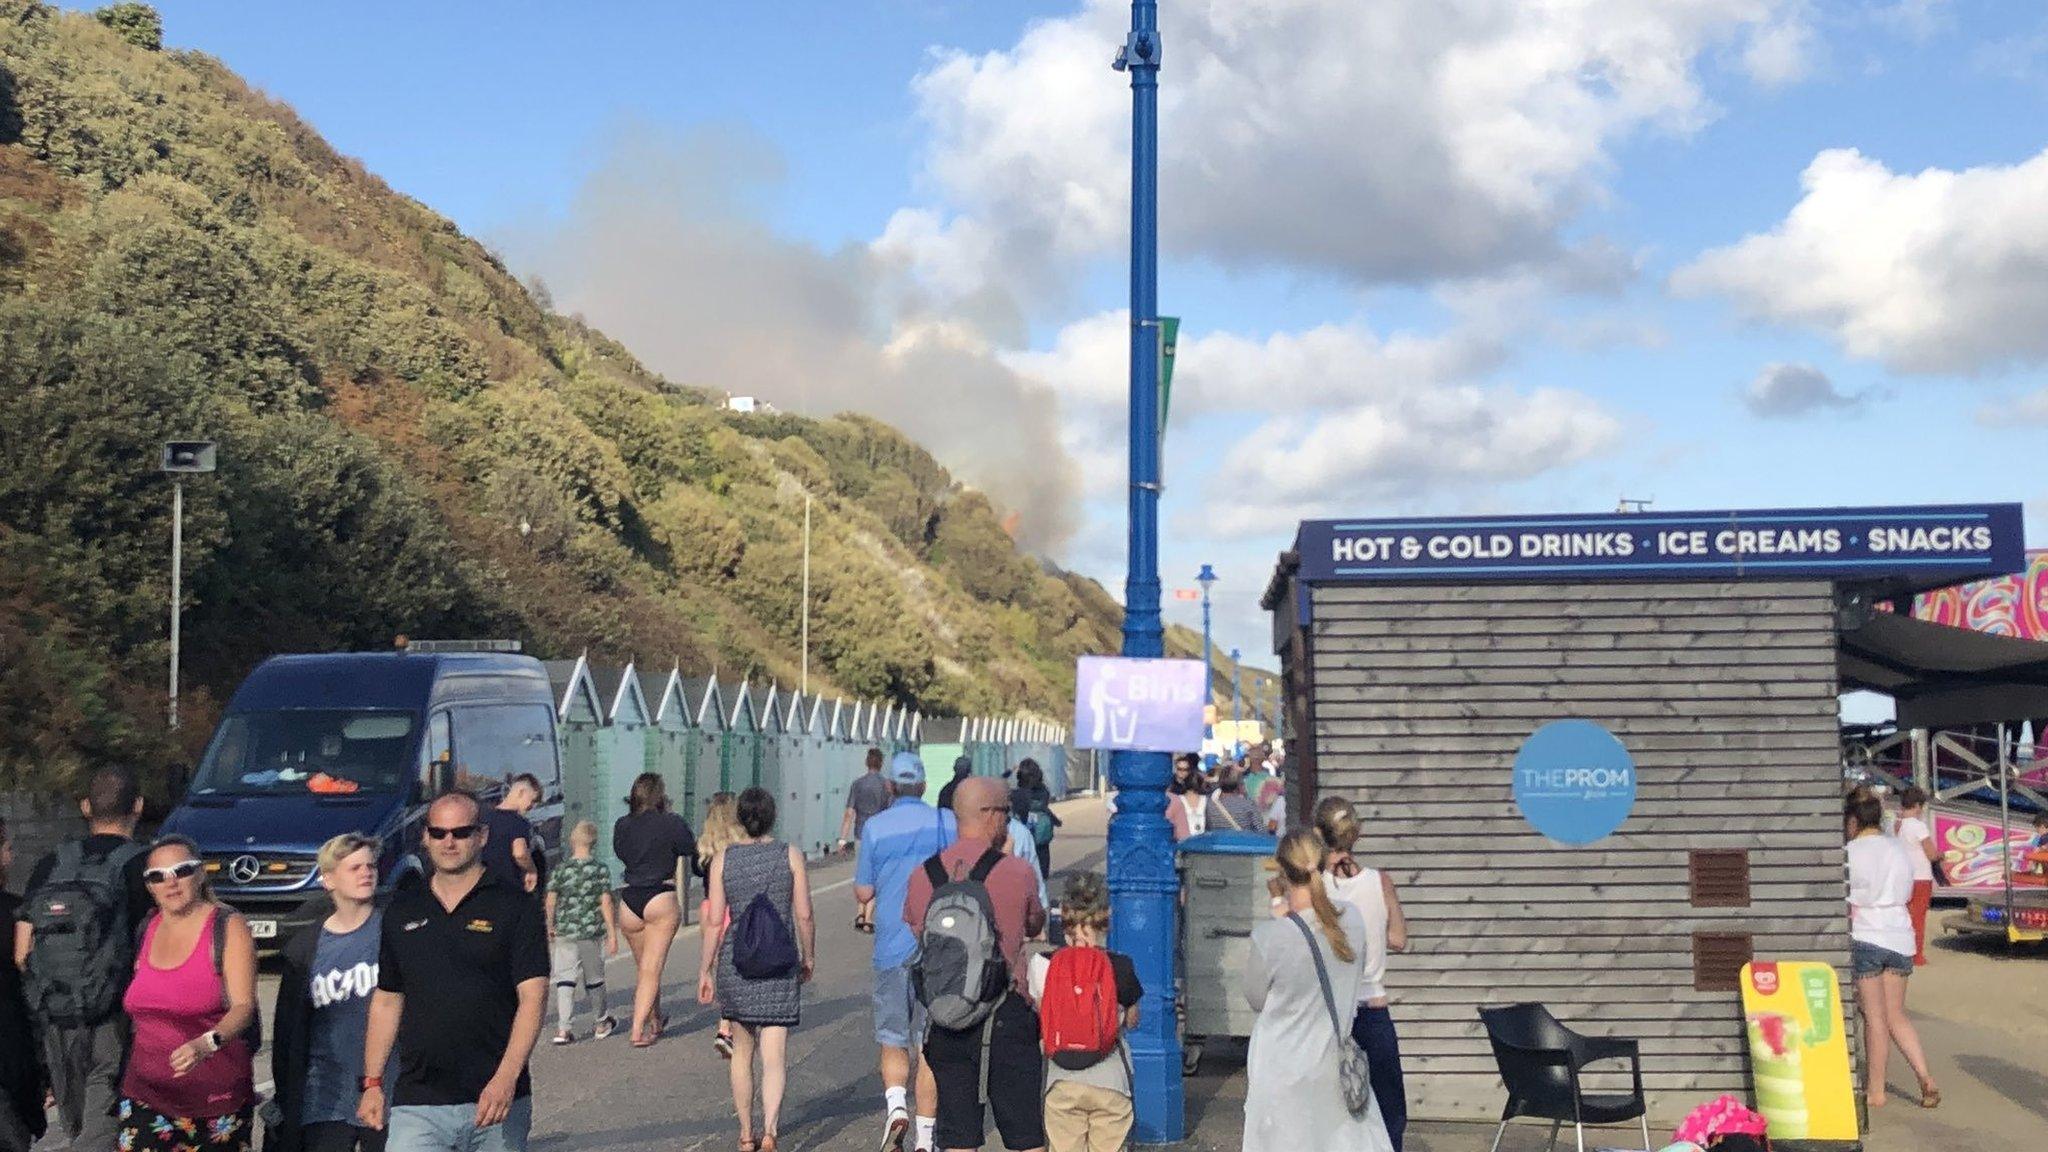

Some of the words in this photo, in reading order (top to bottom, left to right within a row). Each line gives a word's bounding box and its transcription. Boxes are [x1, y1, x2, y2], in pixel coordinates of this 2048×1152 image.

[1332, 537, 1395, 561] HOT
[1400, 535, 1423, 560] &
[1427, 534, 1514, 559] COLD
[1519, 532, 1634, 558] DRINKS
[1658, 531, 1707, 555] ICE
[1715, 528, 1842, 554] CREAMS
[1867, 526, 1992, 552] SNACKS
[1128, 674, 1197, 701] Bins
